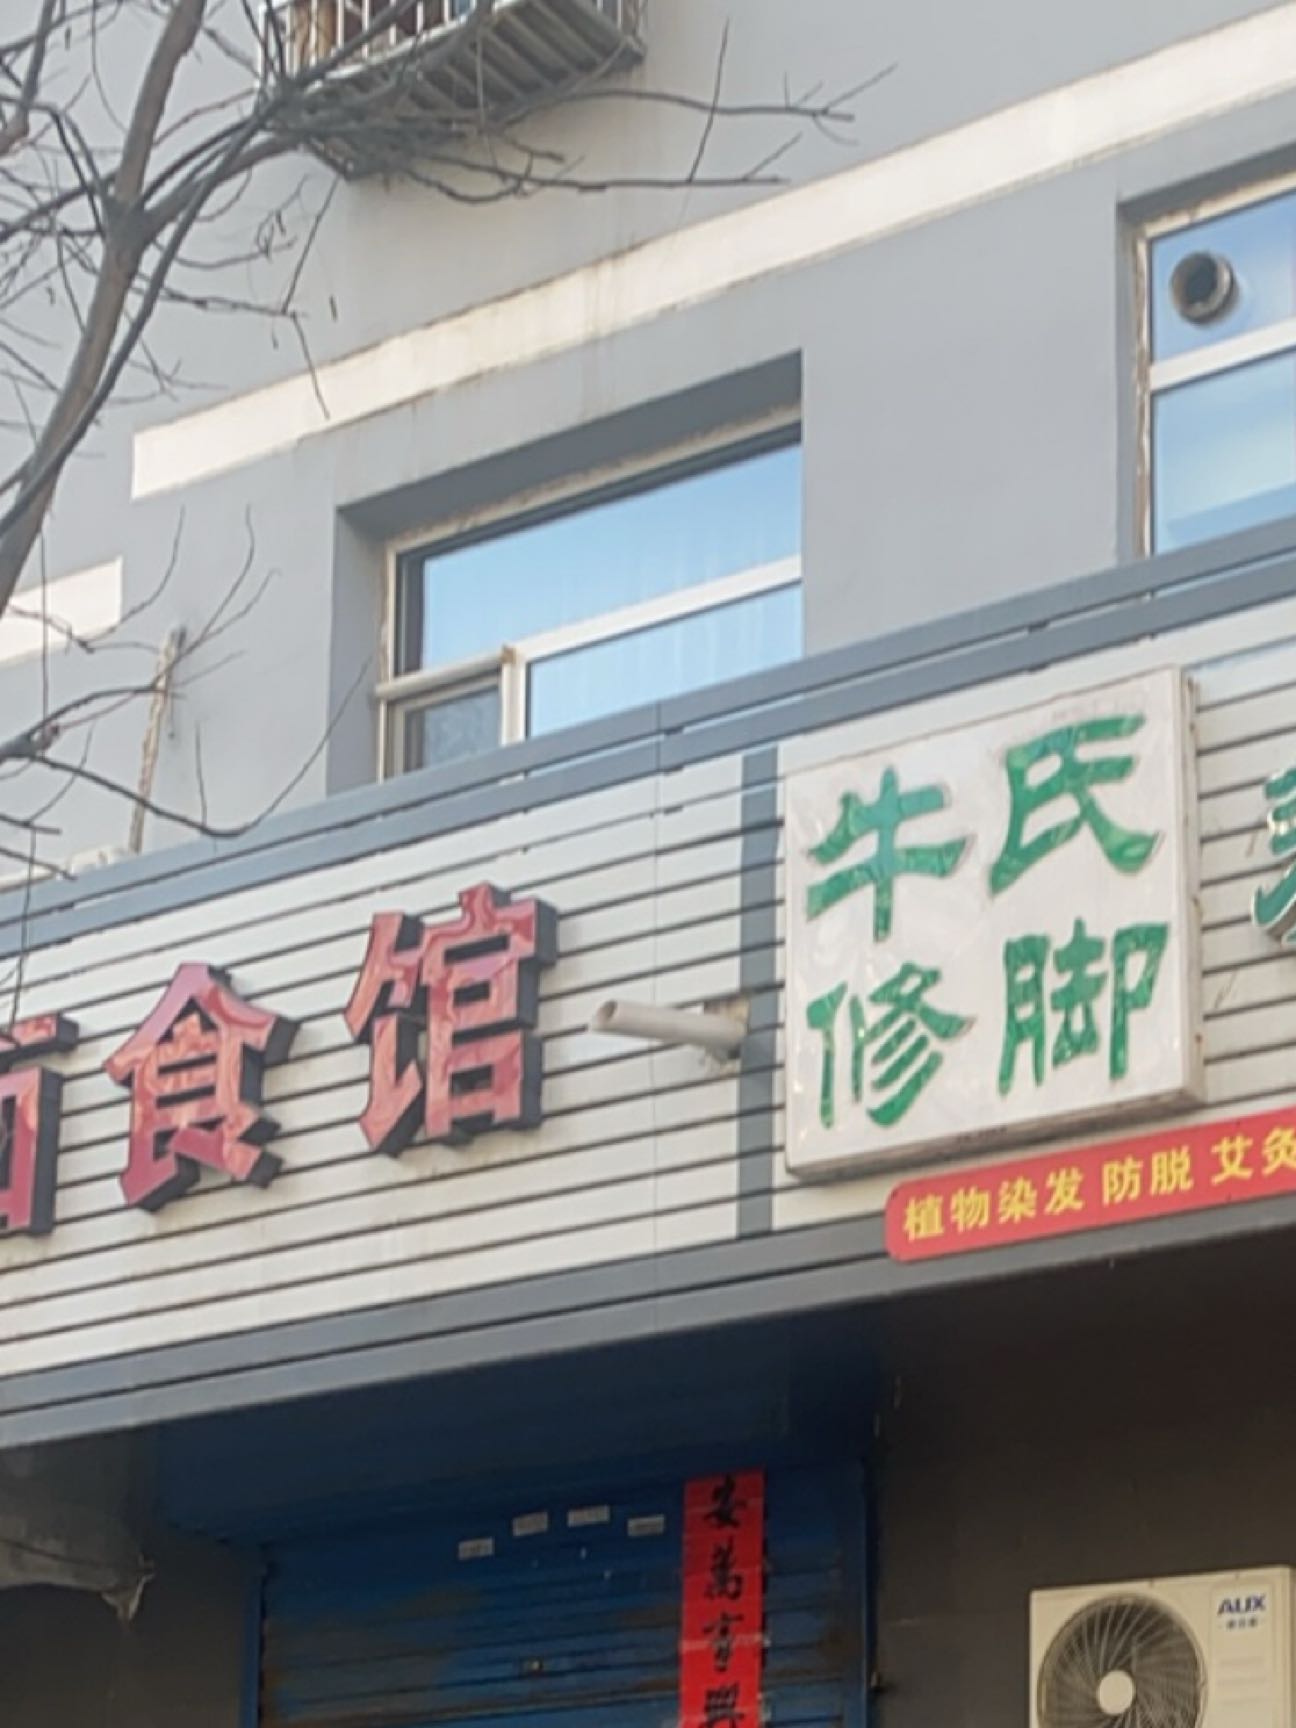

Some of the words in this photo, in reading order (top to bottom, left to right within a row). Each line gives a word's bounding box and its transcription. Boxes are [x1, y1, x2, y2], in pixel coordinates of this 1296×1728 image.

[806, 714, 1159, 942] 牛氏
[806, 917, 1170, 1129] 修脚
[903, 1167, 1086, 1242] 植物染发
[1102, 1146, 1195, 1205] 防脱
[1217, 1594, 1267, 1615] AUX
